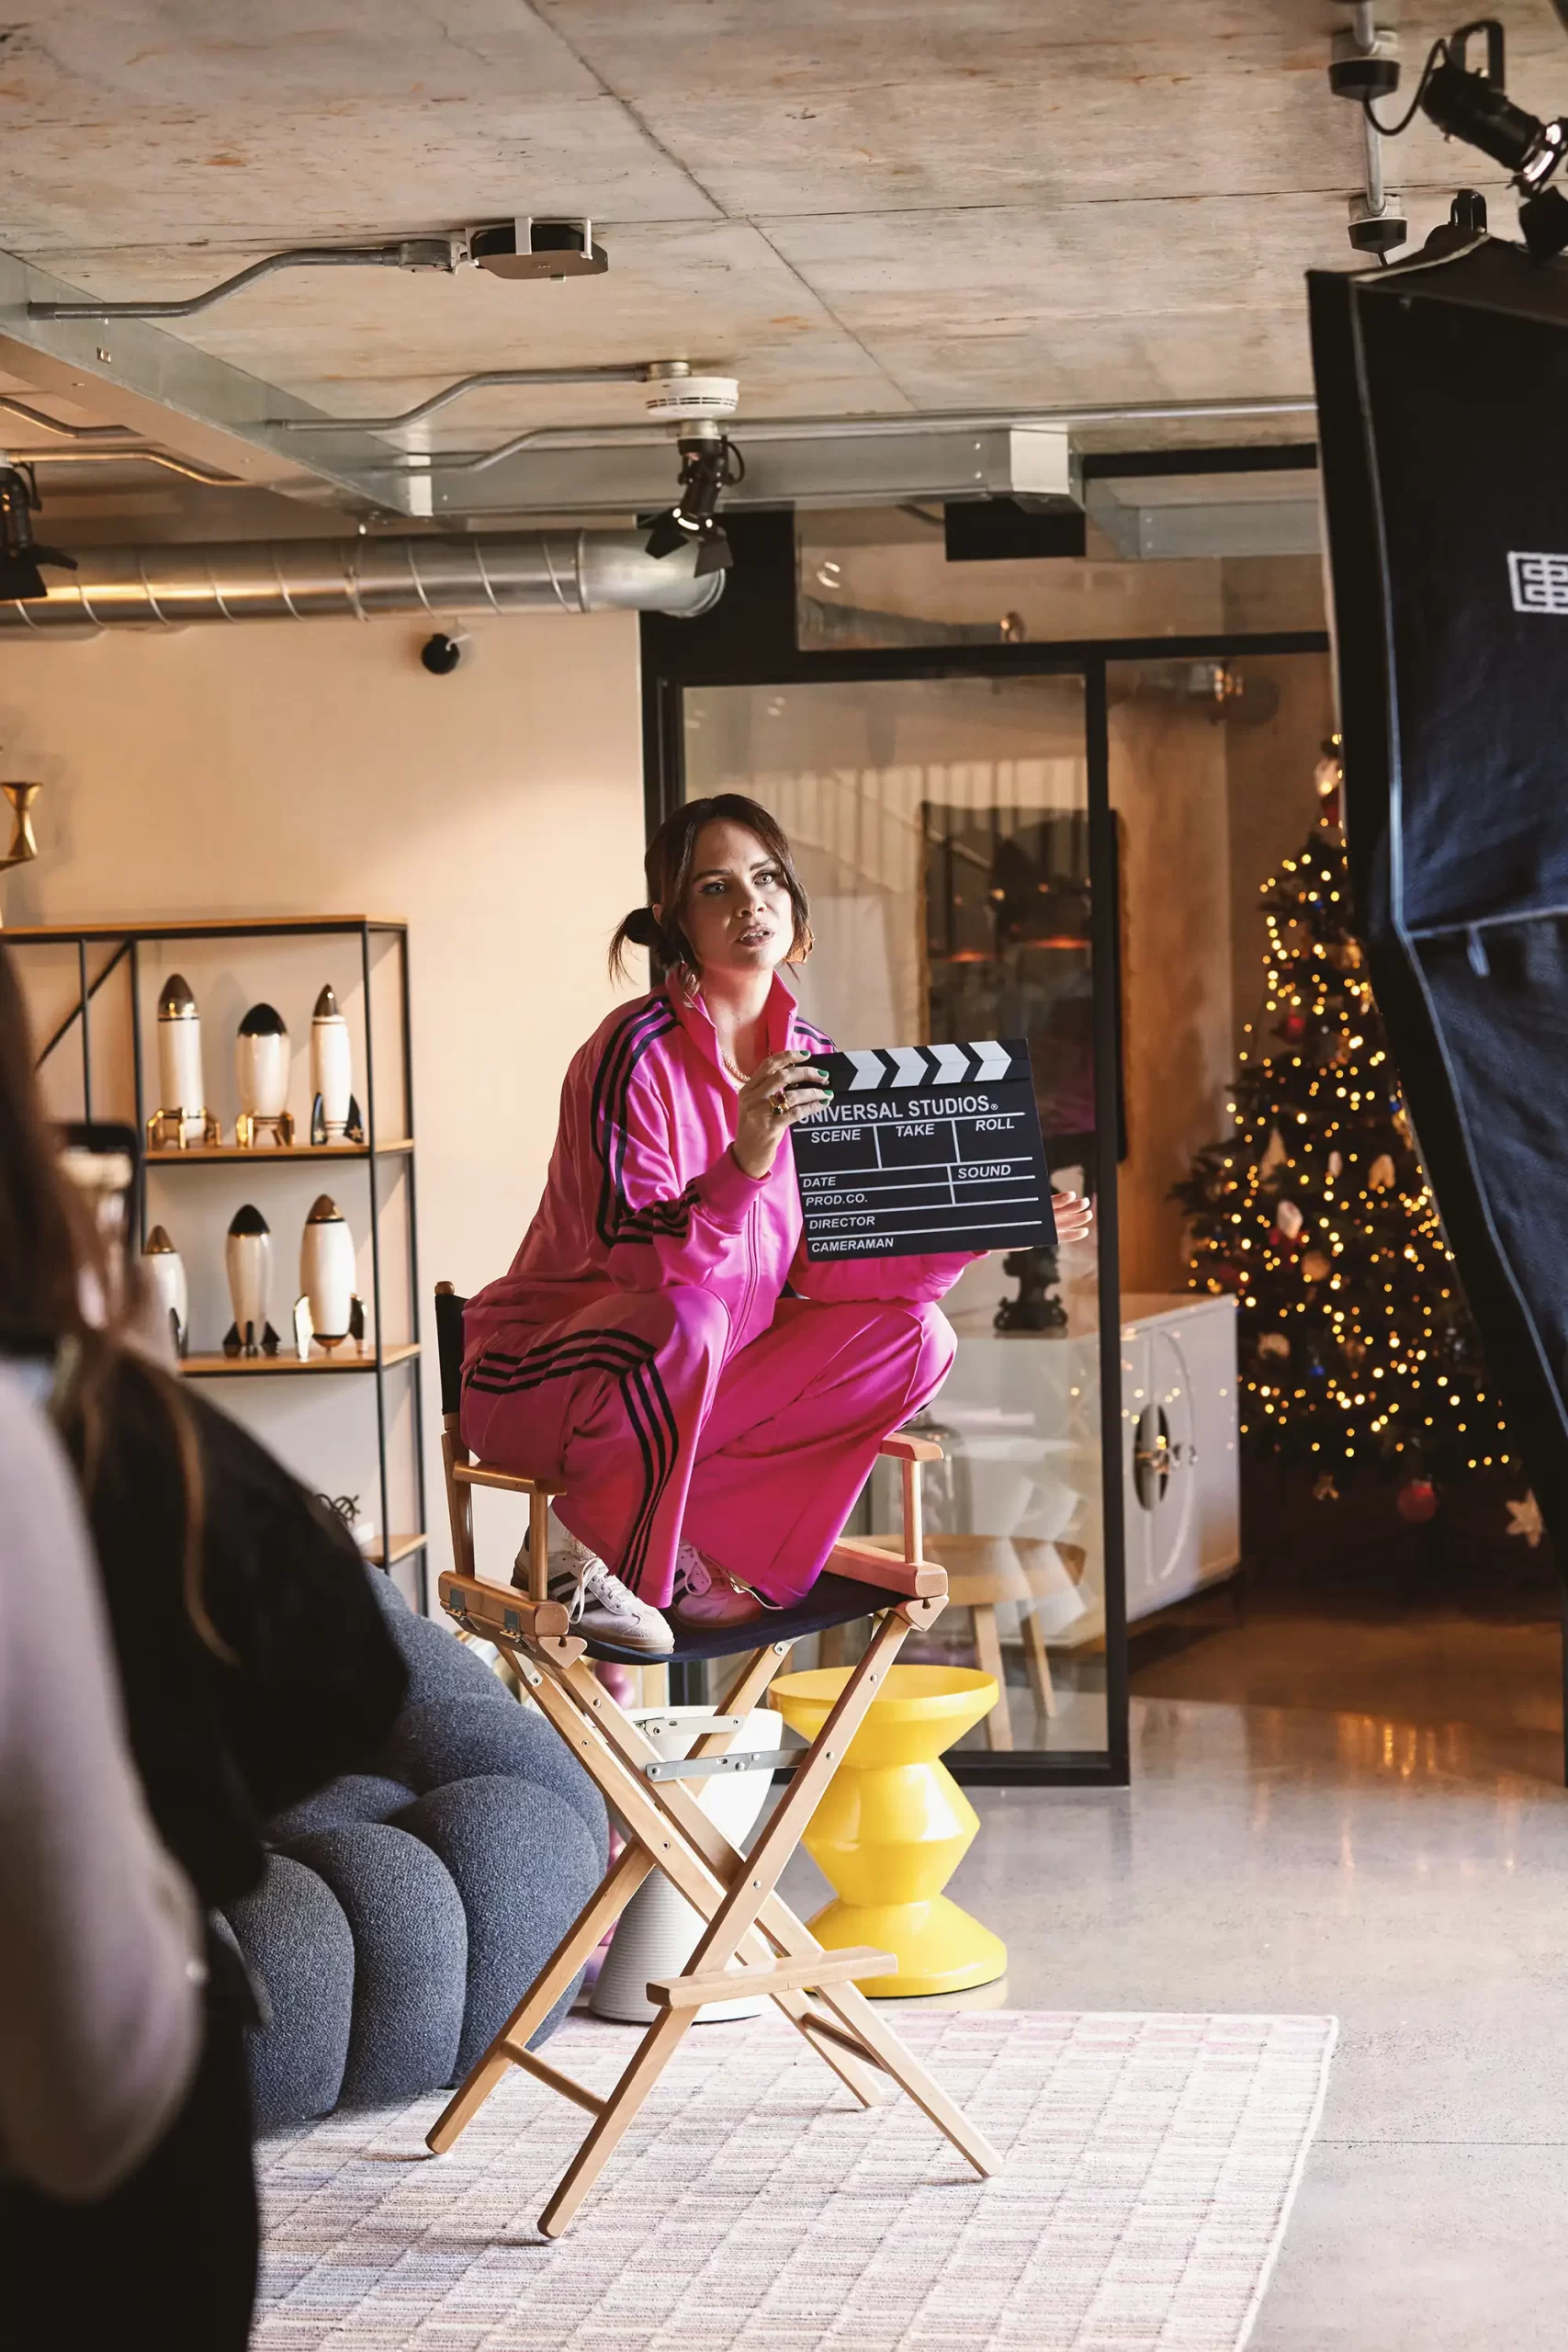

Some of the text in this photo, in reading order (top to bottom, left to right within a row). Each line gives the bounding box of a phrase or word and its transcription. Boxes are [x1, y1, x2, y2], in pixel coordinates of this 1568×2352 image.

[896, 1123, 935, 1137] TAKE
[976, 1118, 1015, 1132] ROLL
[810, 1128, 862, 1143] SCENE
[957, 1164, 1011, 1179] SOUND
[803, 1176, 837, 1188] DATE
[806, 1193, 868, 1206] PROD.CO.
[809, 1216, 875, 1229] DIRECTOR
[811, 1238, 894, 1252] CAMERAMAN
